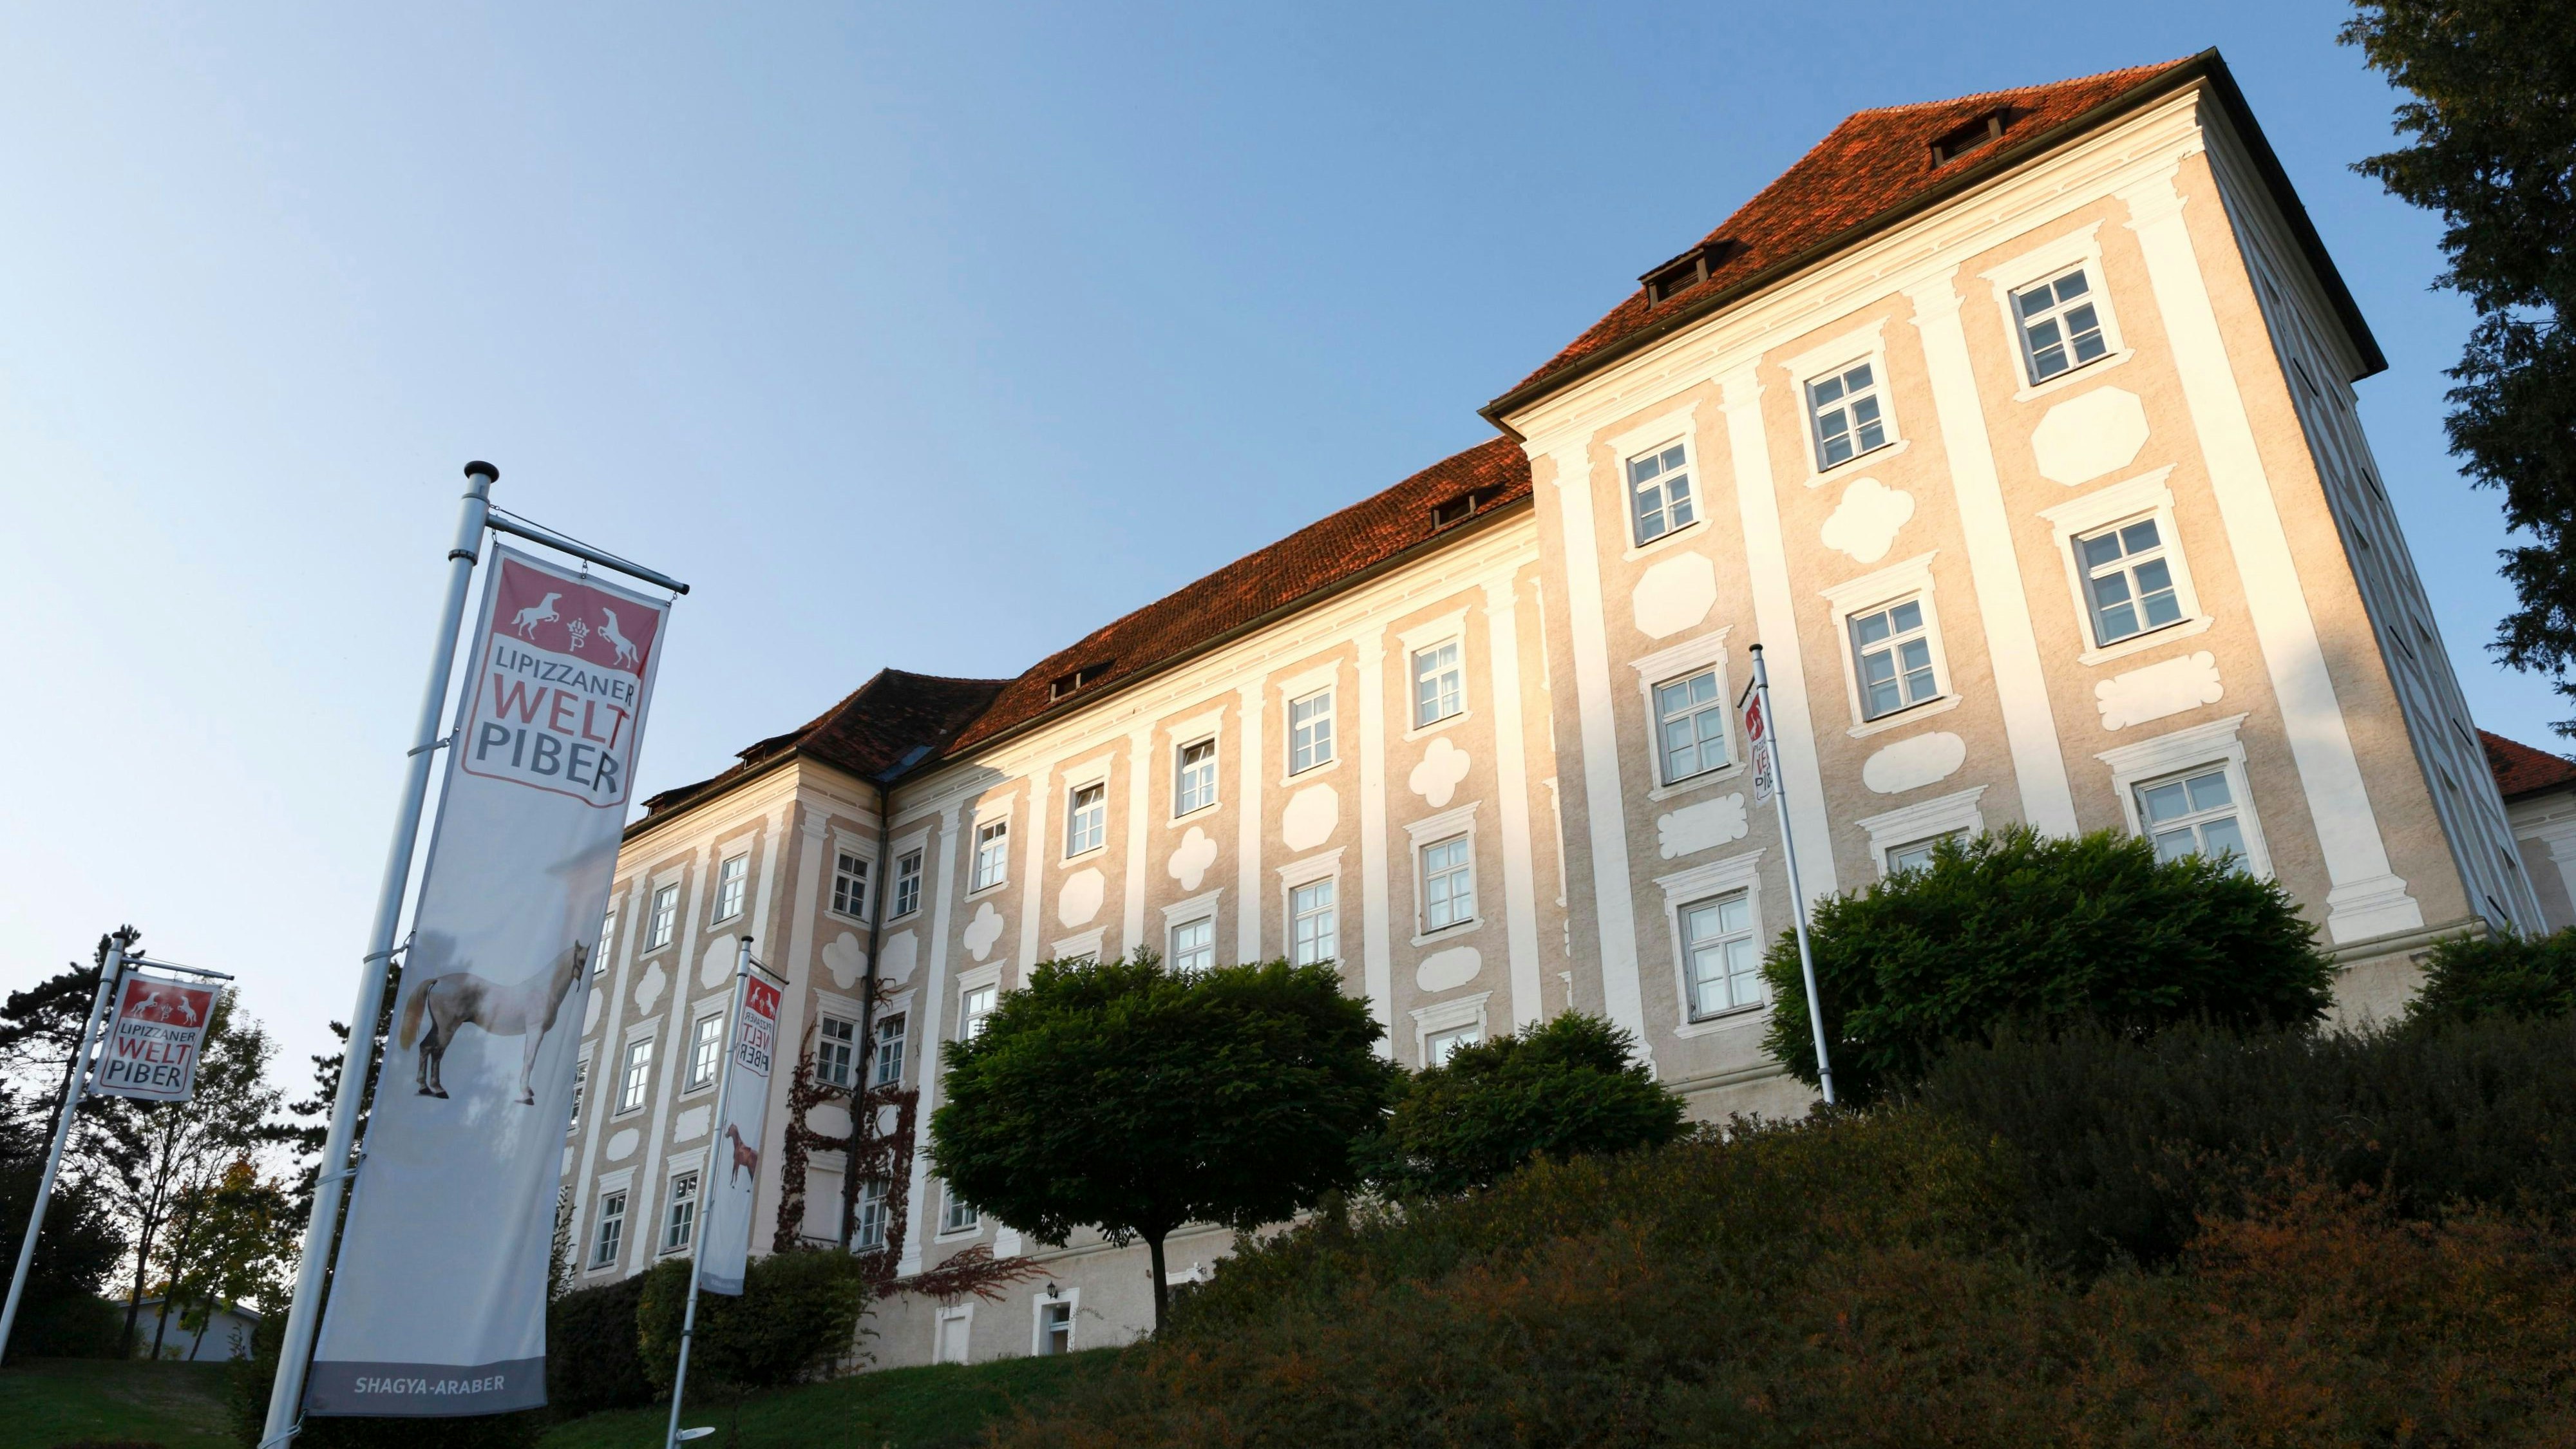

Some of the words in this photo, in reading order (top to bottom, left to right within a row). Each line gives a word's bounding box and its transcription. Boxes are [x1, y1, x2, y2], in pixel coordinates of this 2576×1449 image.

[495, 645, 634, 707] LIPIZZANER
[493, 673, 630, 750] WELT
[476, 721, 619, 794] PIBER
[120, 1023, 196, 1042] LIPIZZANER
[118, 1036, 191, 1065] WELT
[107, 1059, 180, 1087] PIBER
[354, 1375, 505, 1395] SHAGYA-ARABER
